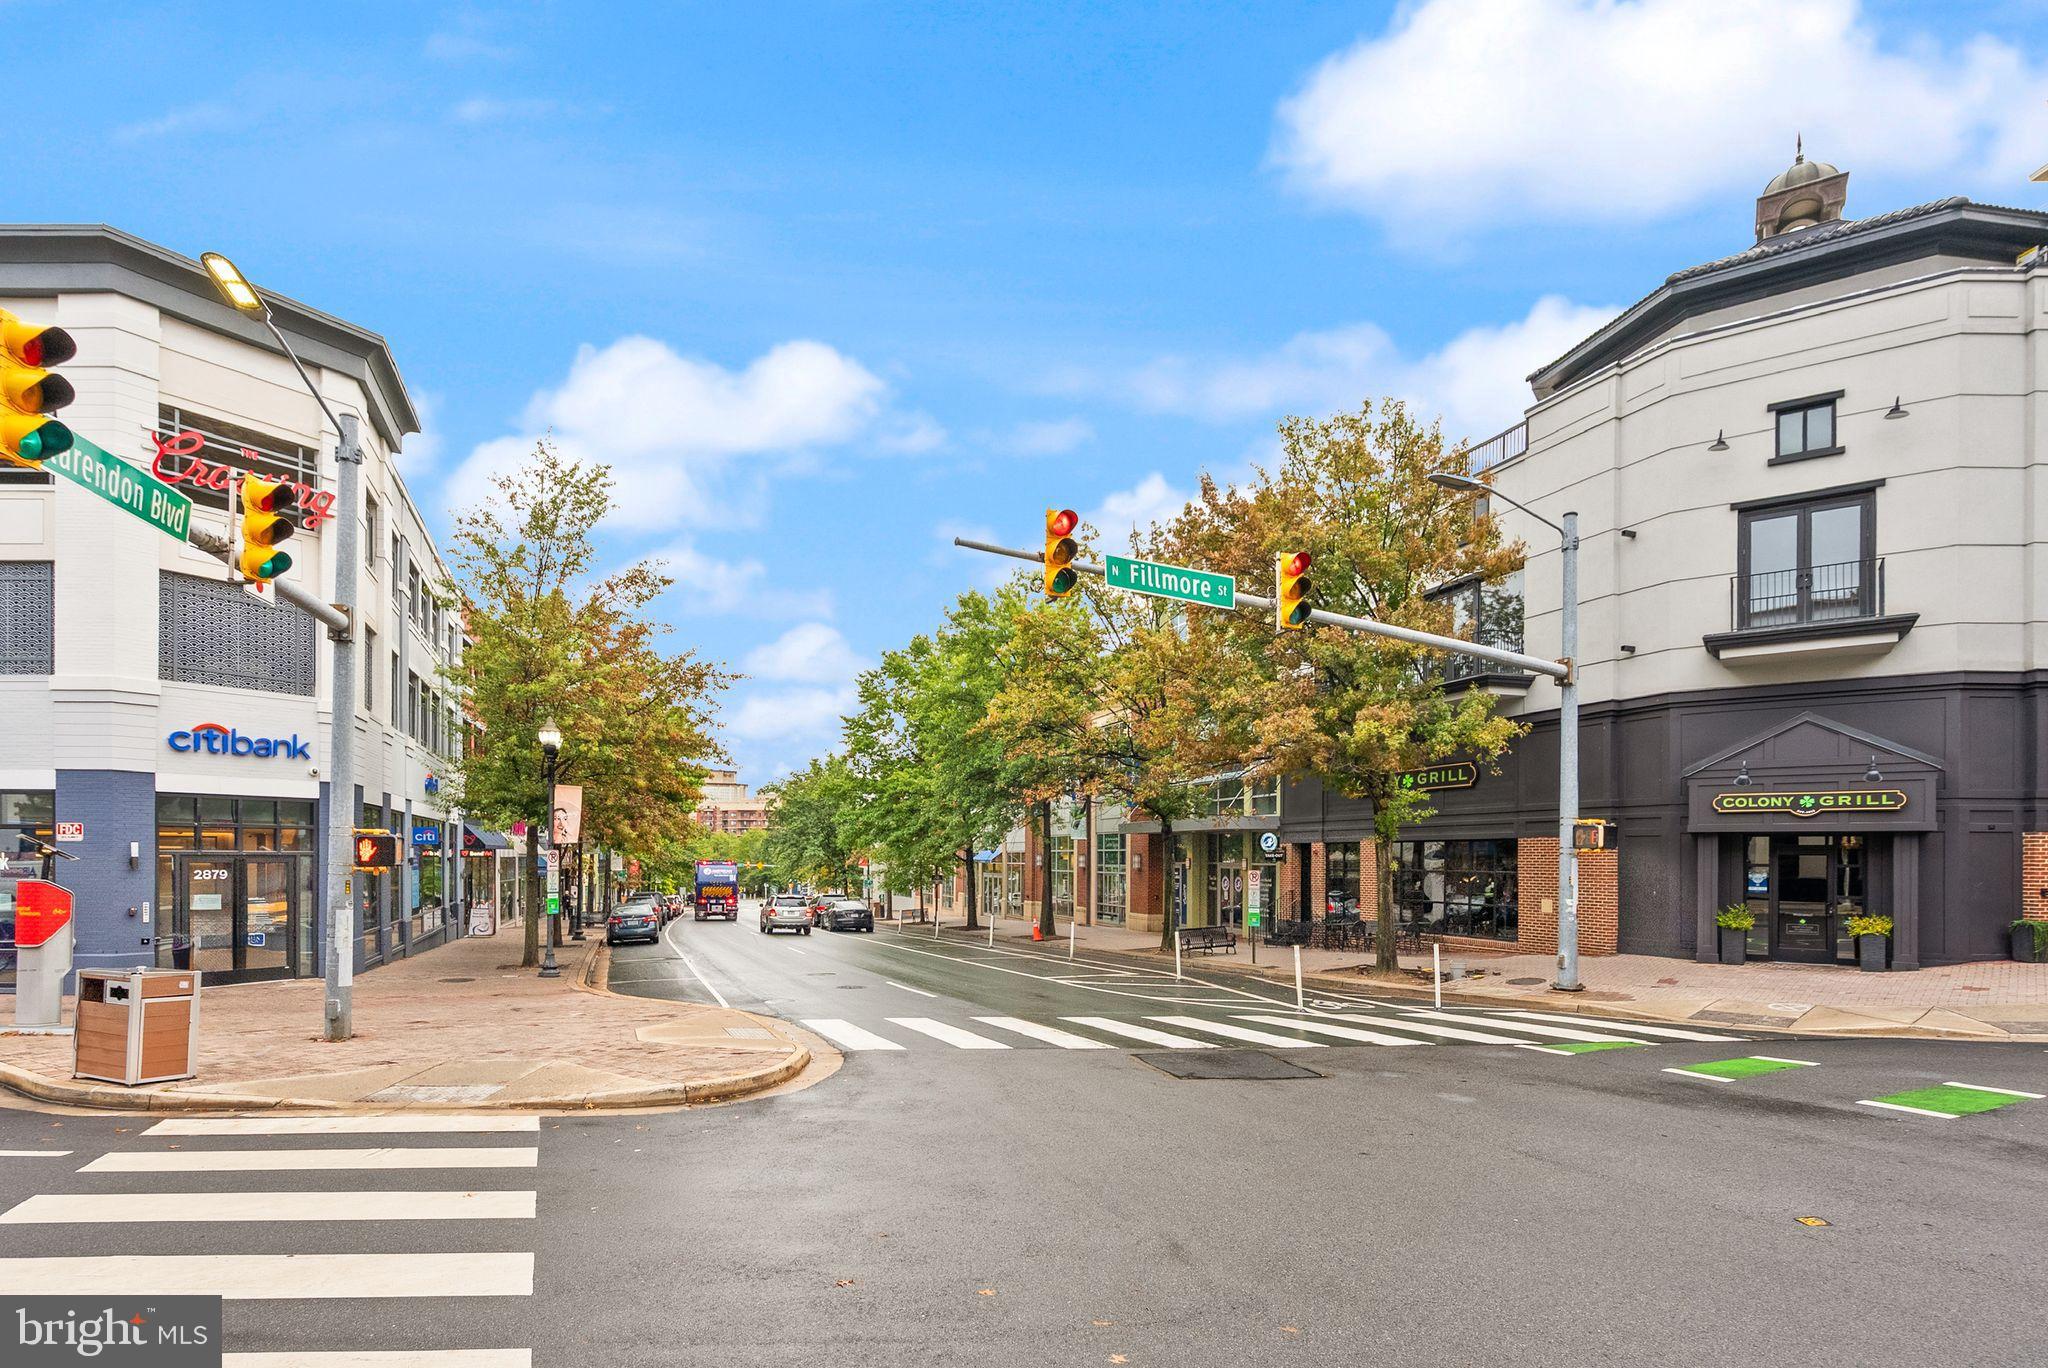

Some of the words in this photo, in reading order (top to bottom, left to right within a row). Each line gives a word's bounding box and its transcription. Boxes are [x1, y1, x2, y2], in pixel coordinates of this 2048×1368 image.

[50, 448, 145, 511] arendon
[150, 488, 186, 533] Blvd
[1111, 564, 1119, 577] N
[1129, 563, 1212, 598] Fillmore
[1217, 584, 1227, 597] St
[168, 724, 311, 760] citibank
[1417, 768, 1468, 785] GRILL
[1722, 796, 1794, 808] COLONY
[1819, 794, 1896, 806] GRILL
[59, 824, 81, 835] FDC
[414, 830, 435, 841] citi
[193, 869, 229, 880] 2879
